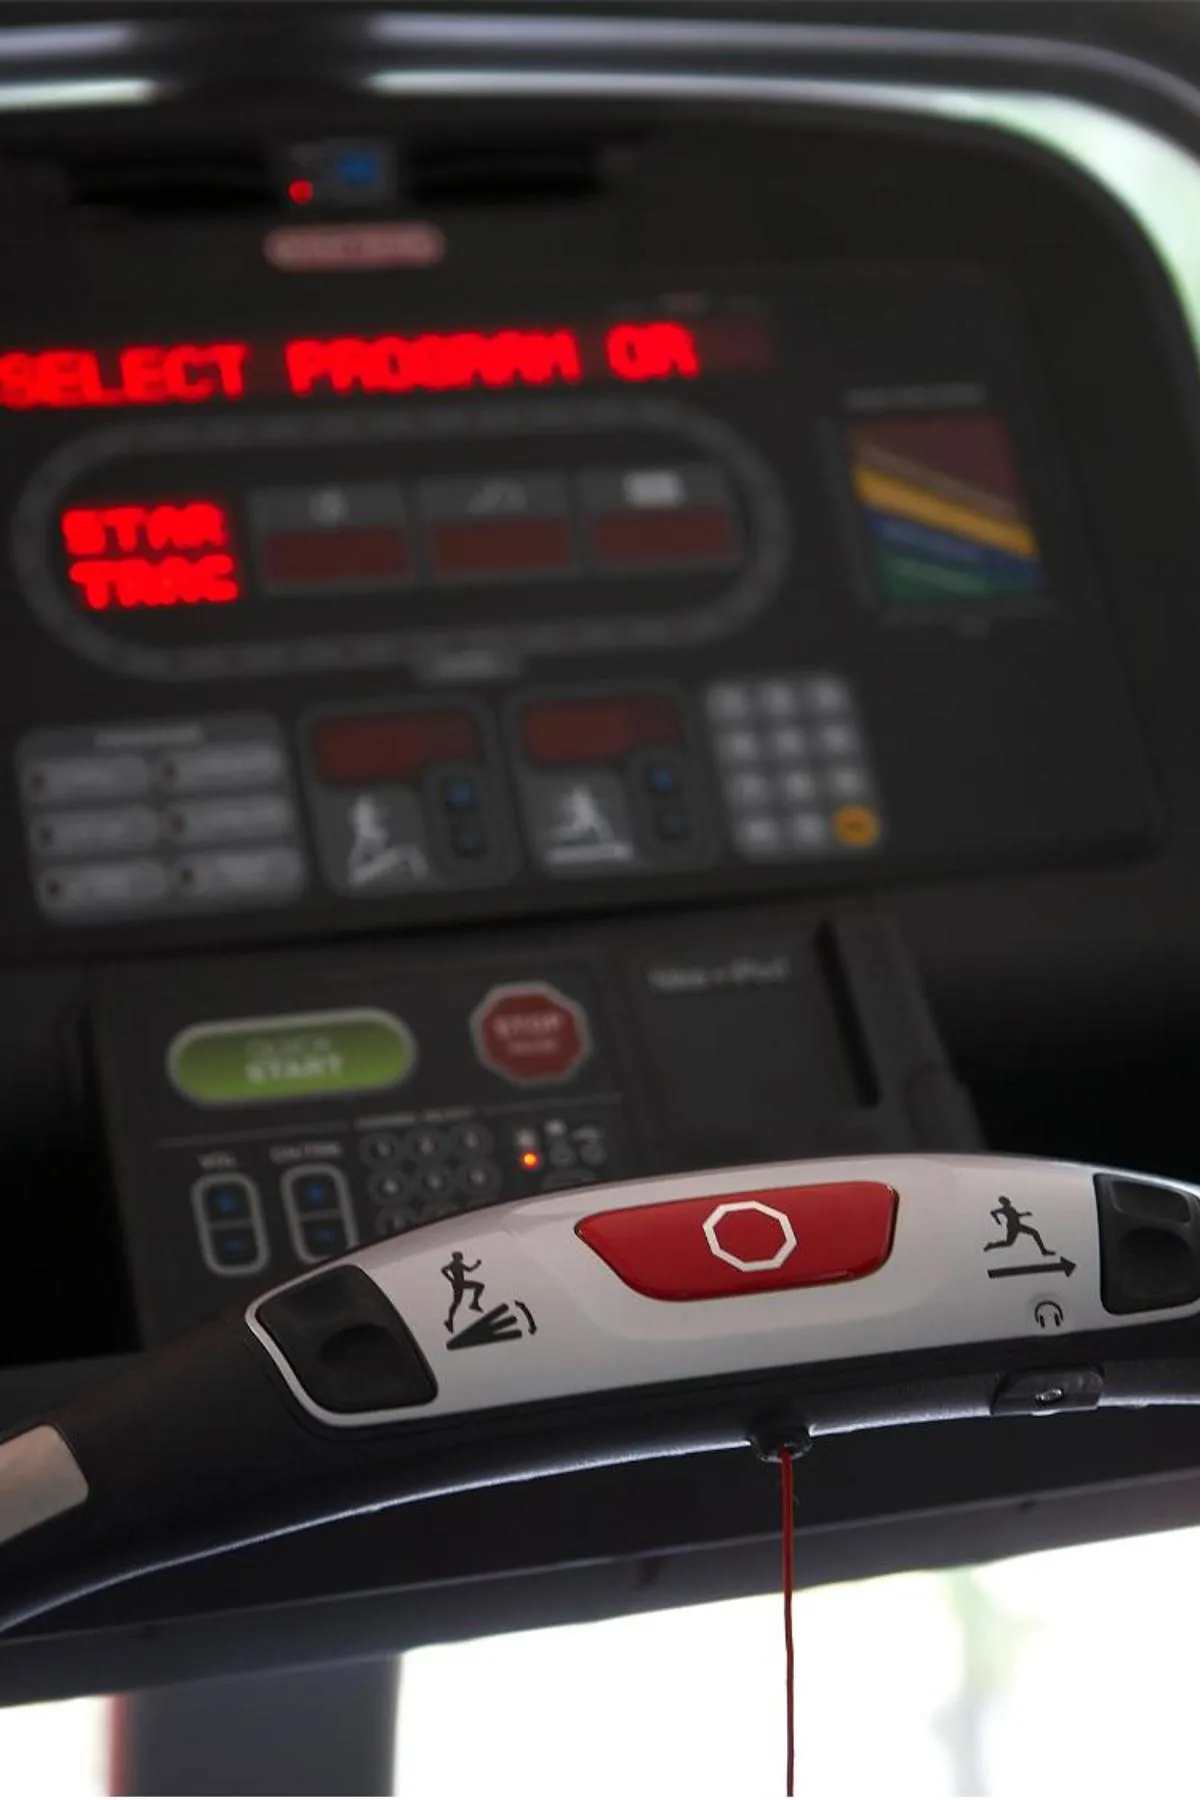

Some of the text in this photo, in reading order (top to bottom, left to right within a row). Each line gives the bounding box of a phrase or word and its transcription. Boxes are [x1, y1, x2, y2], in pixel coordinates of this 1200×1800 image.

[0, 323, 699, 407] SELECT PROGRAM OR
[62, 502, 228, 555] STAR
[69, 554, 239, 609] TRAC
